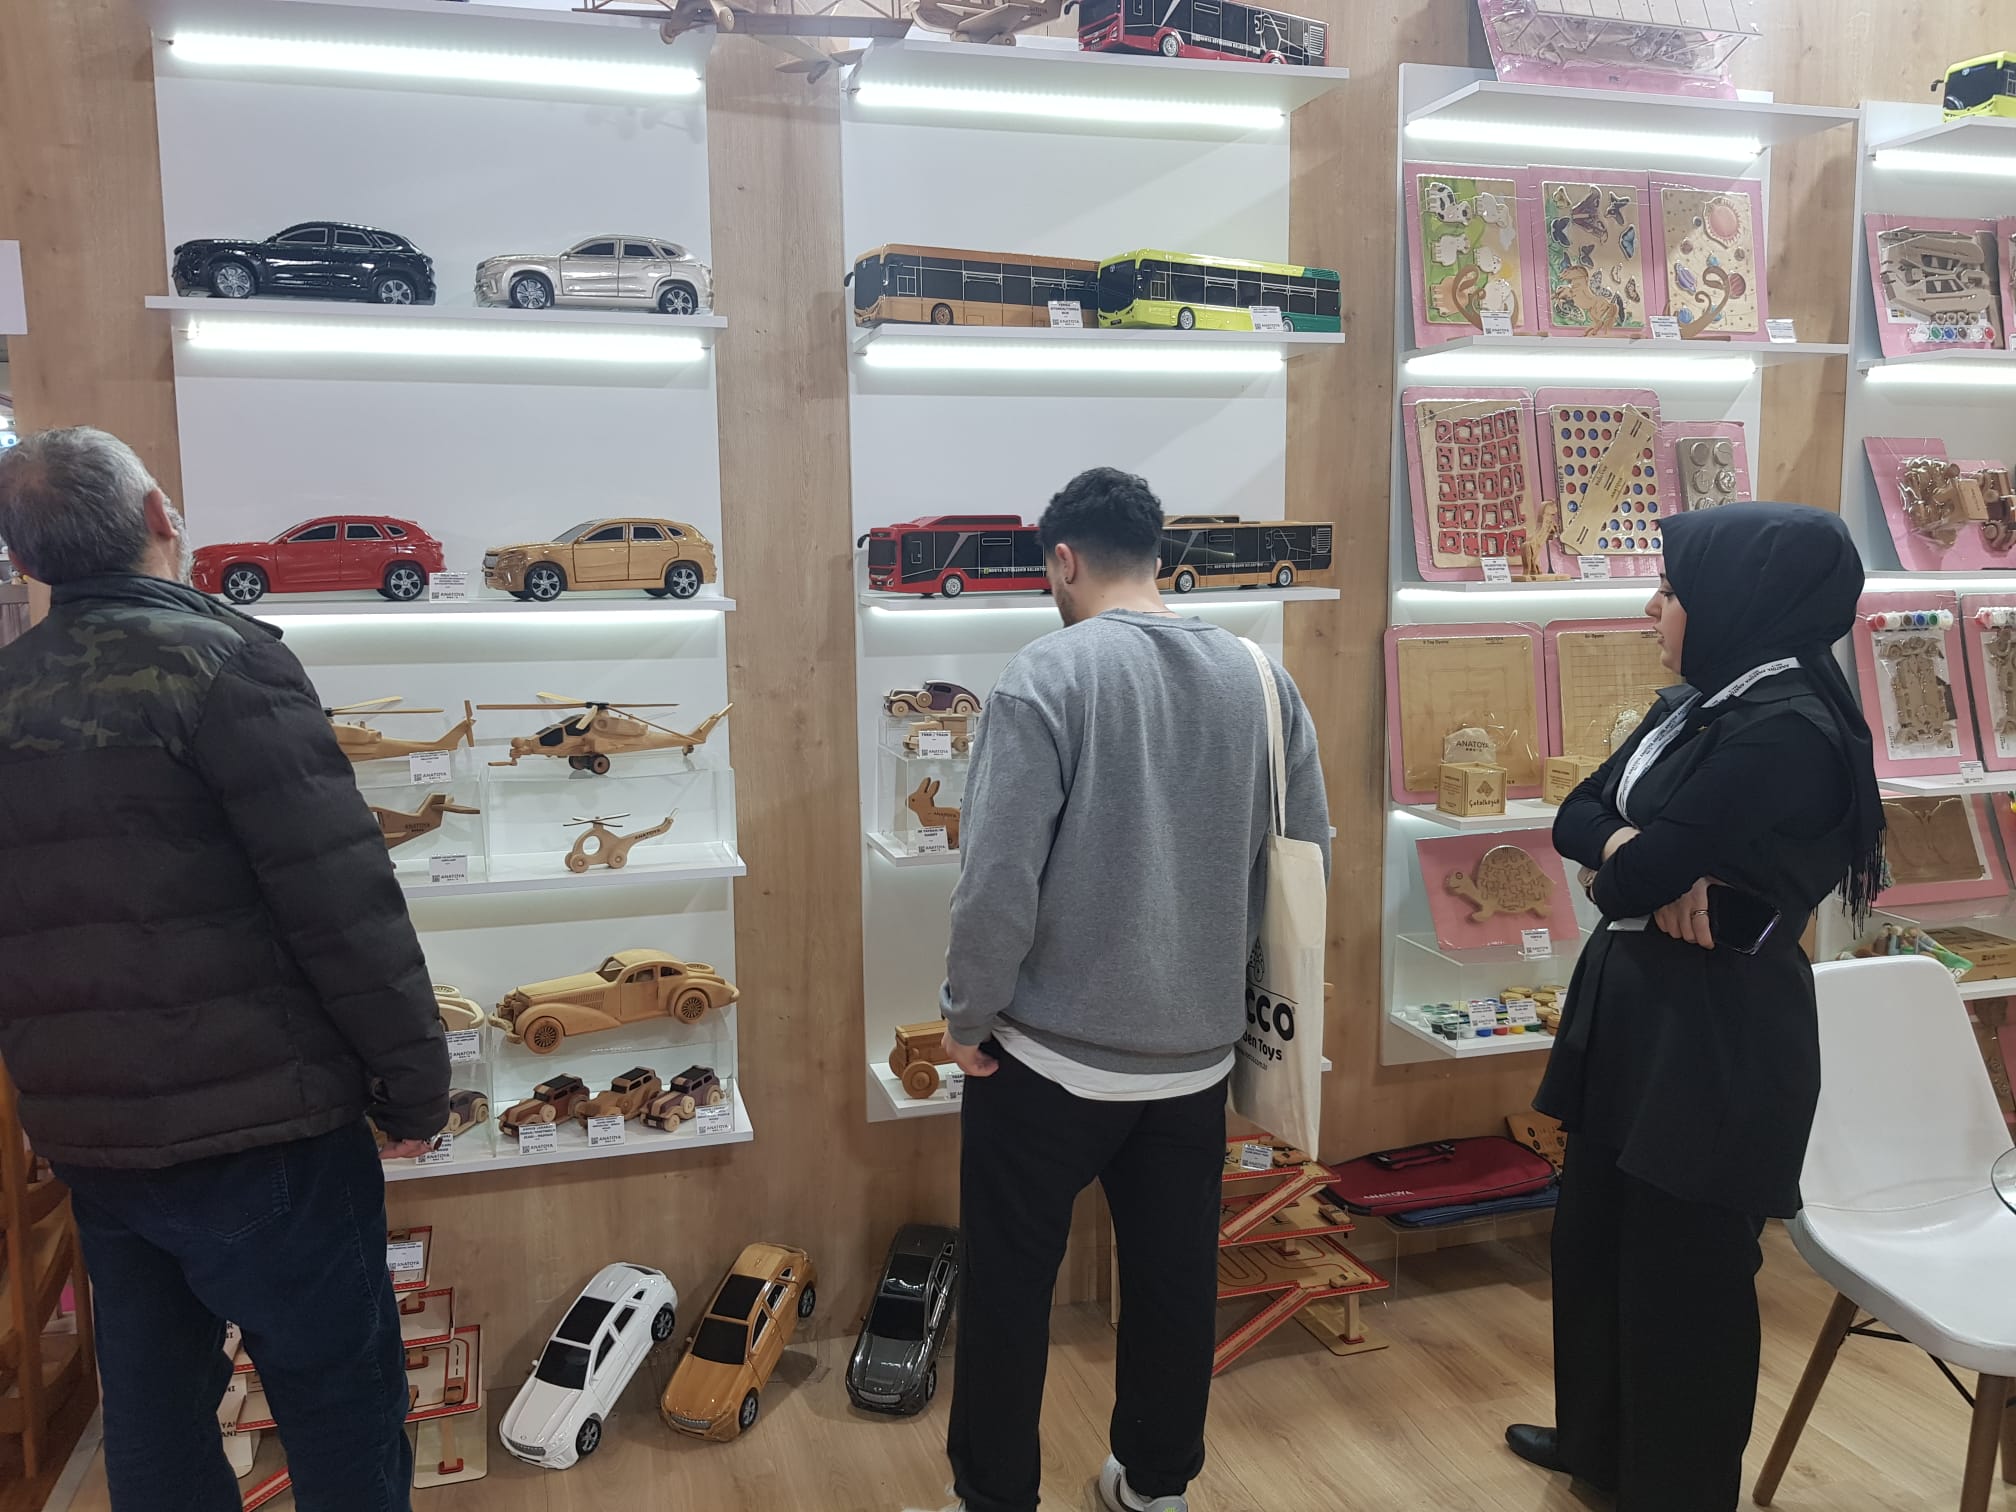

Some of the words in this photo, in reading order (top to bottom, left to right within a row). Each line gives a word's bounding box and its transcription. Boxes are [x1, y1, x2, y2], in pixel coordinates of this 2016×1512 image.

[1455, 740, 1489, 749] ANATOYA
[634, 829, 661, 839] ANATOYA
[1245, 987, 1295, 1041] CCO
[1242, 1029, 1257, 1049] den
[1257, 1038, 1282, 1061] Toys
[1363, 1190, 1415, 1199] ANATOYA
